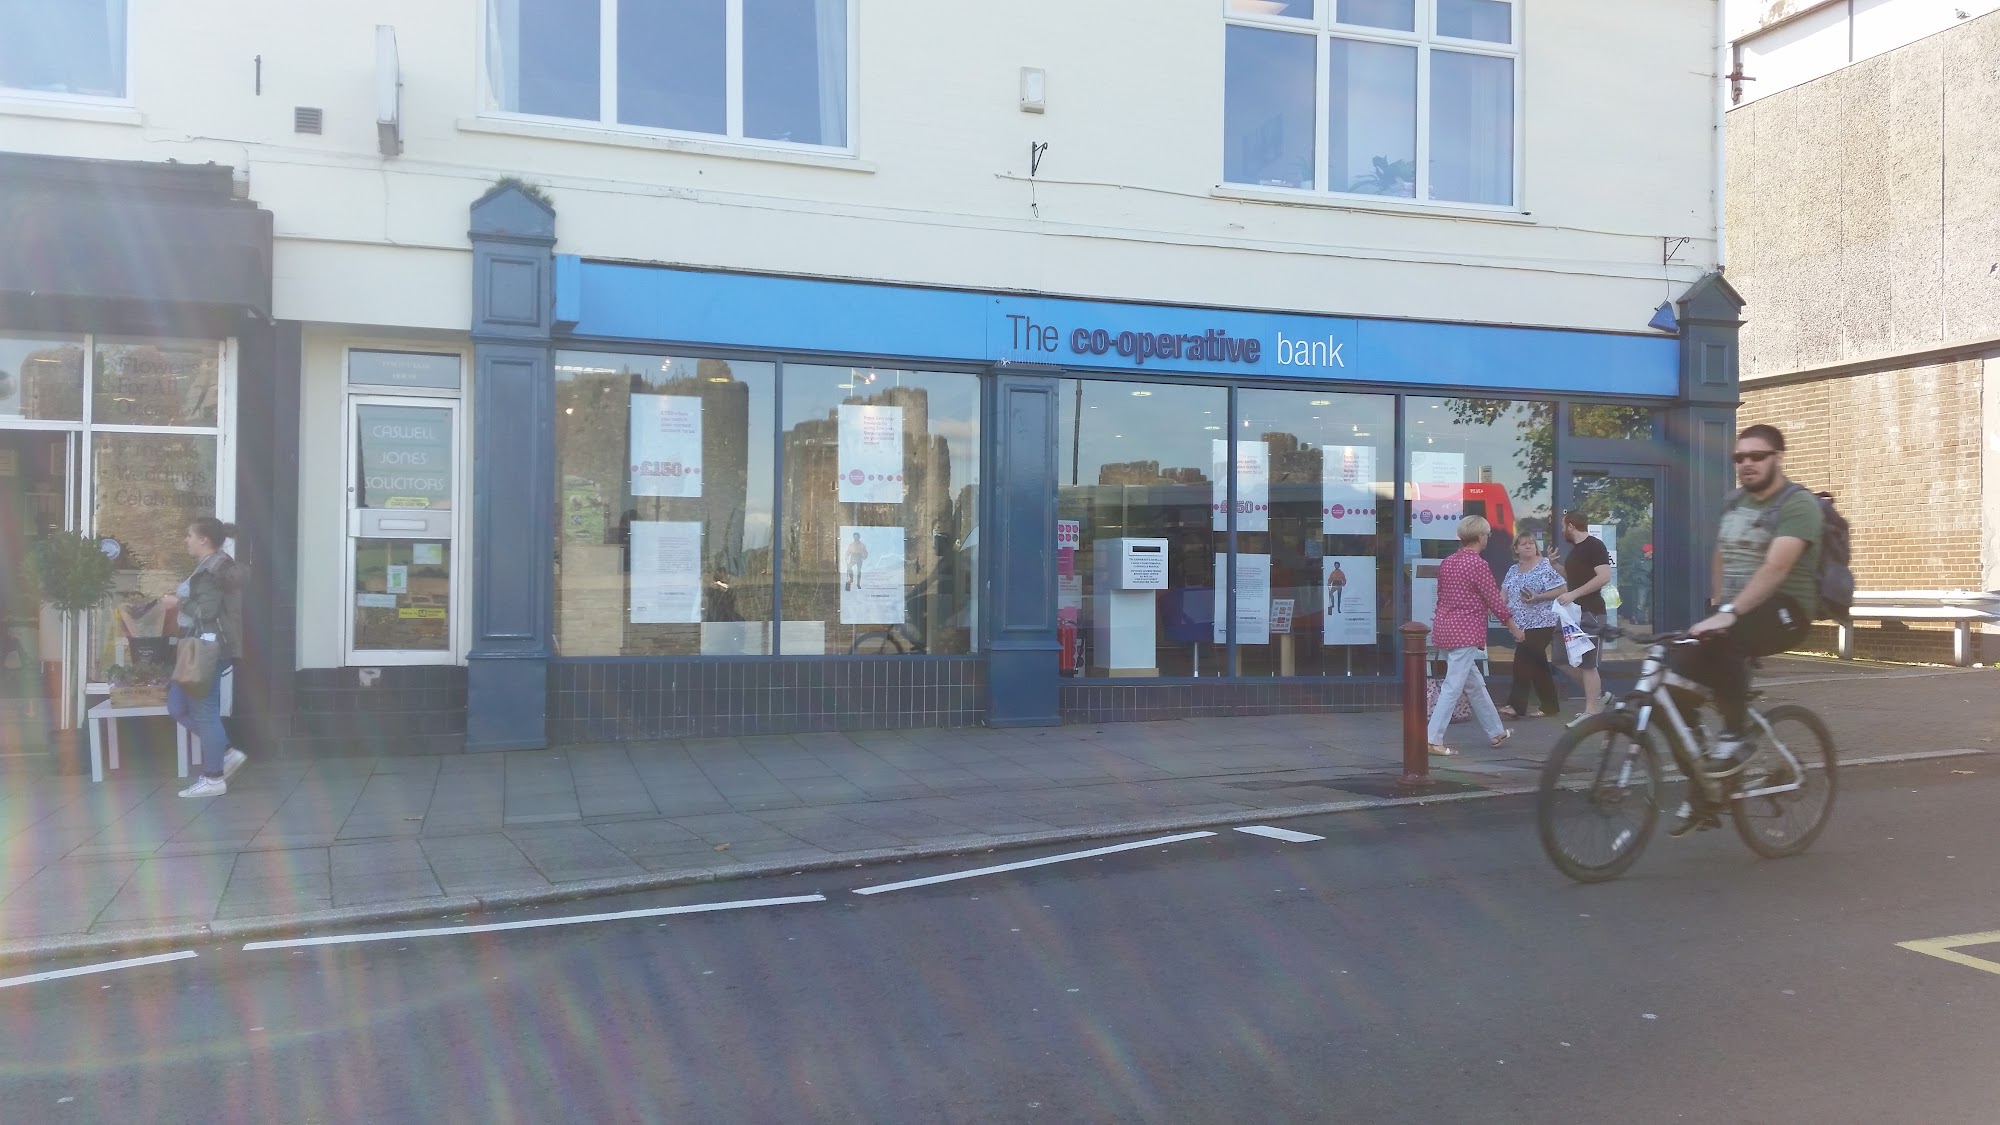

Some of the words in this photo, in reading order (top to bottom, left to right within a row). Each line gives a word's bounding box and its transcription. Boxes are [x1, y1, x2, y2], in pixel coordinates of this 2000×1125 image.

[1006, 314, 1059, 352] The
[1071, 328, 1262, 365] co-operative
[1277, 331, 1345, 368] bank
[372, 425, 435, 439] CASWELL
[380, 451, 428, 465] JONES
[640, 461, 682, 476] £150
[364, 476, 445, 491] SOLICITORS
[1220, 500, 1253, 513] £50
